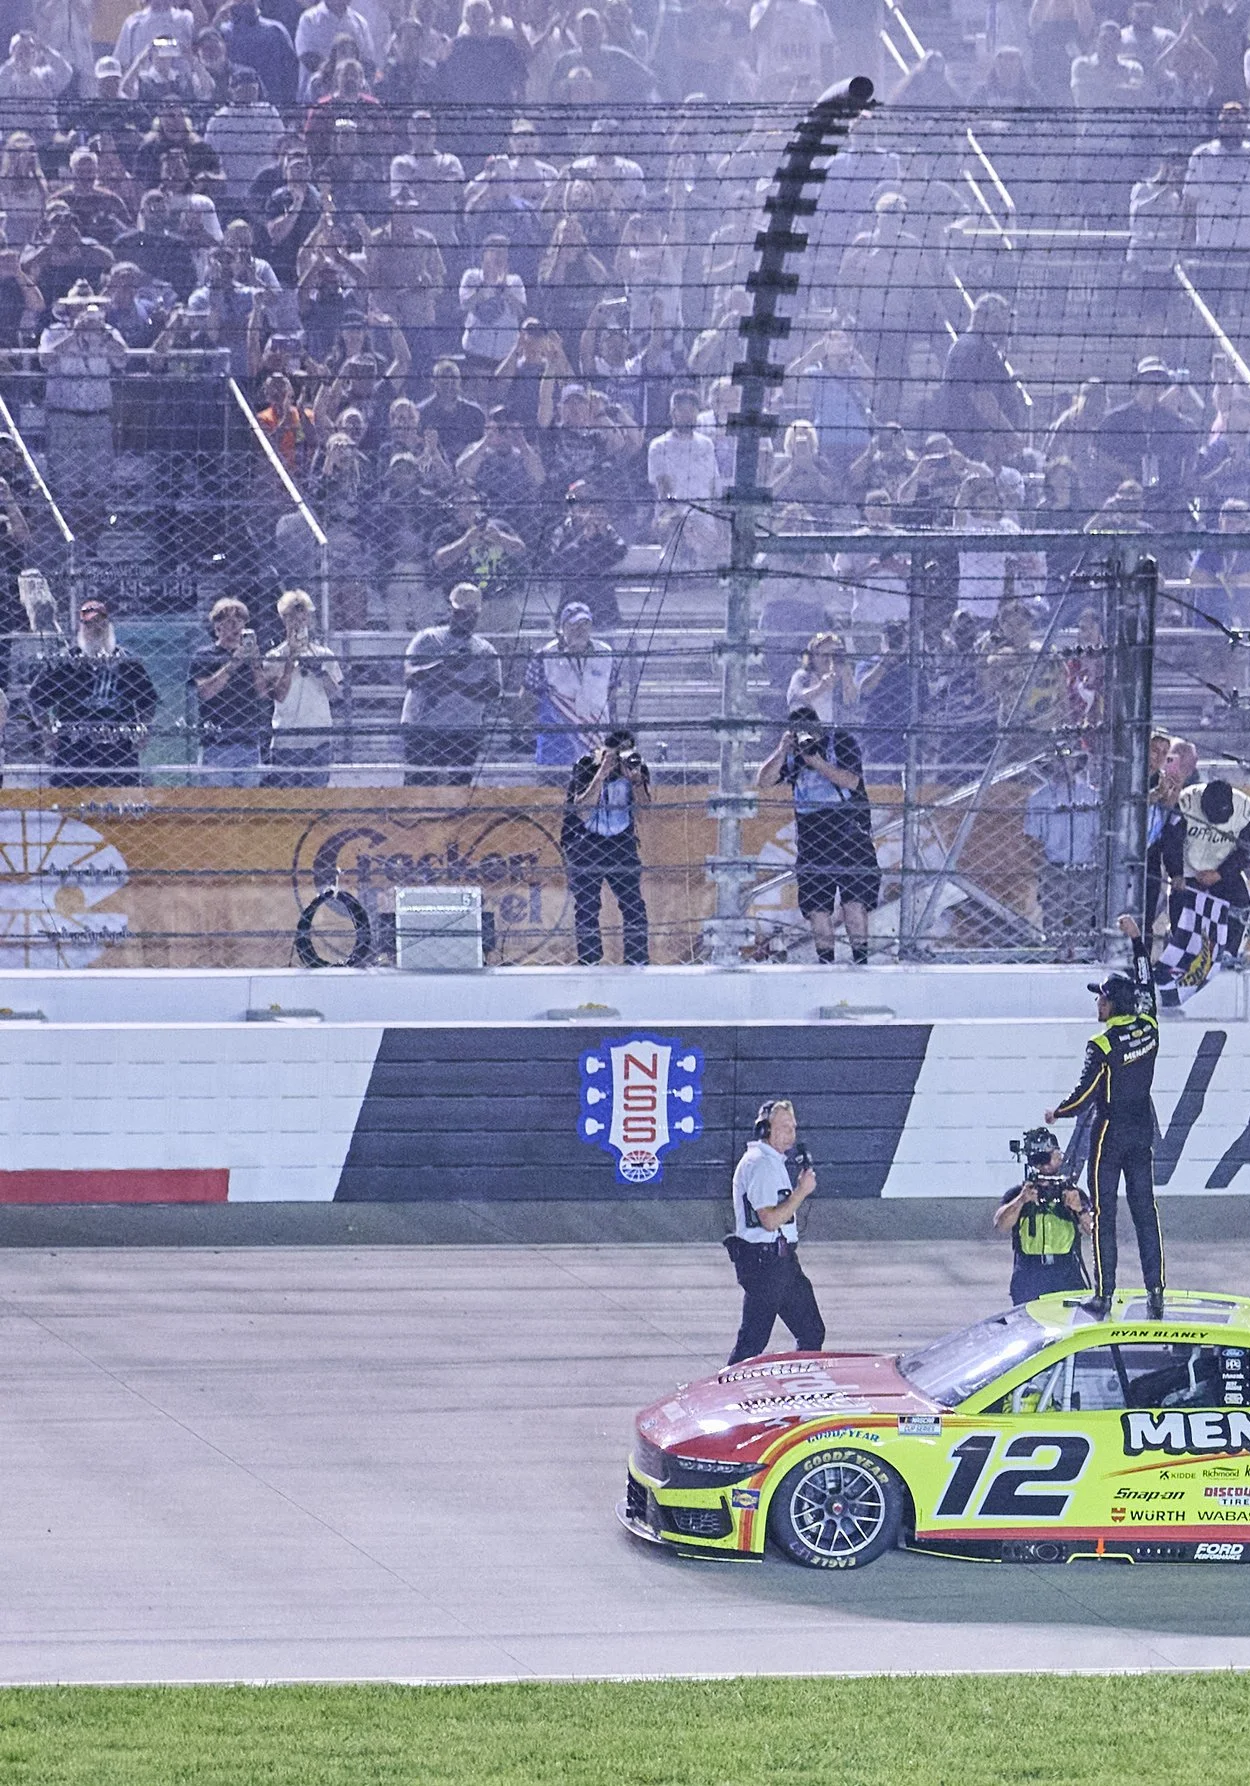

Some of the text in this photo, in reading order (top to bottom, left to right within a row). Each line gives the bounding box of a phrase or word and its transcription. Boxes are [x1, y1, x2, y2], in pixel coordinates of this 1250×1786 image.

[622, 1053, 658, 1144] NSS
[1153, 1331, 1209, 1339] BLANEY
[934, 1433, 1092, 1519] 12
[1202, 1469, 1240, 1478] Richmond
[1114, 1487, 1185, 1502] Snap-on
[1222, 1498, 1250, 1506] TIRE
[1196, 1543, 1244, 1555] FORD
